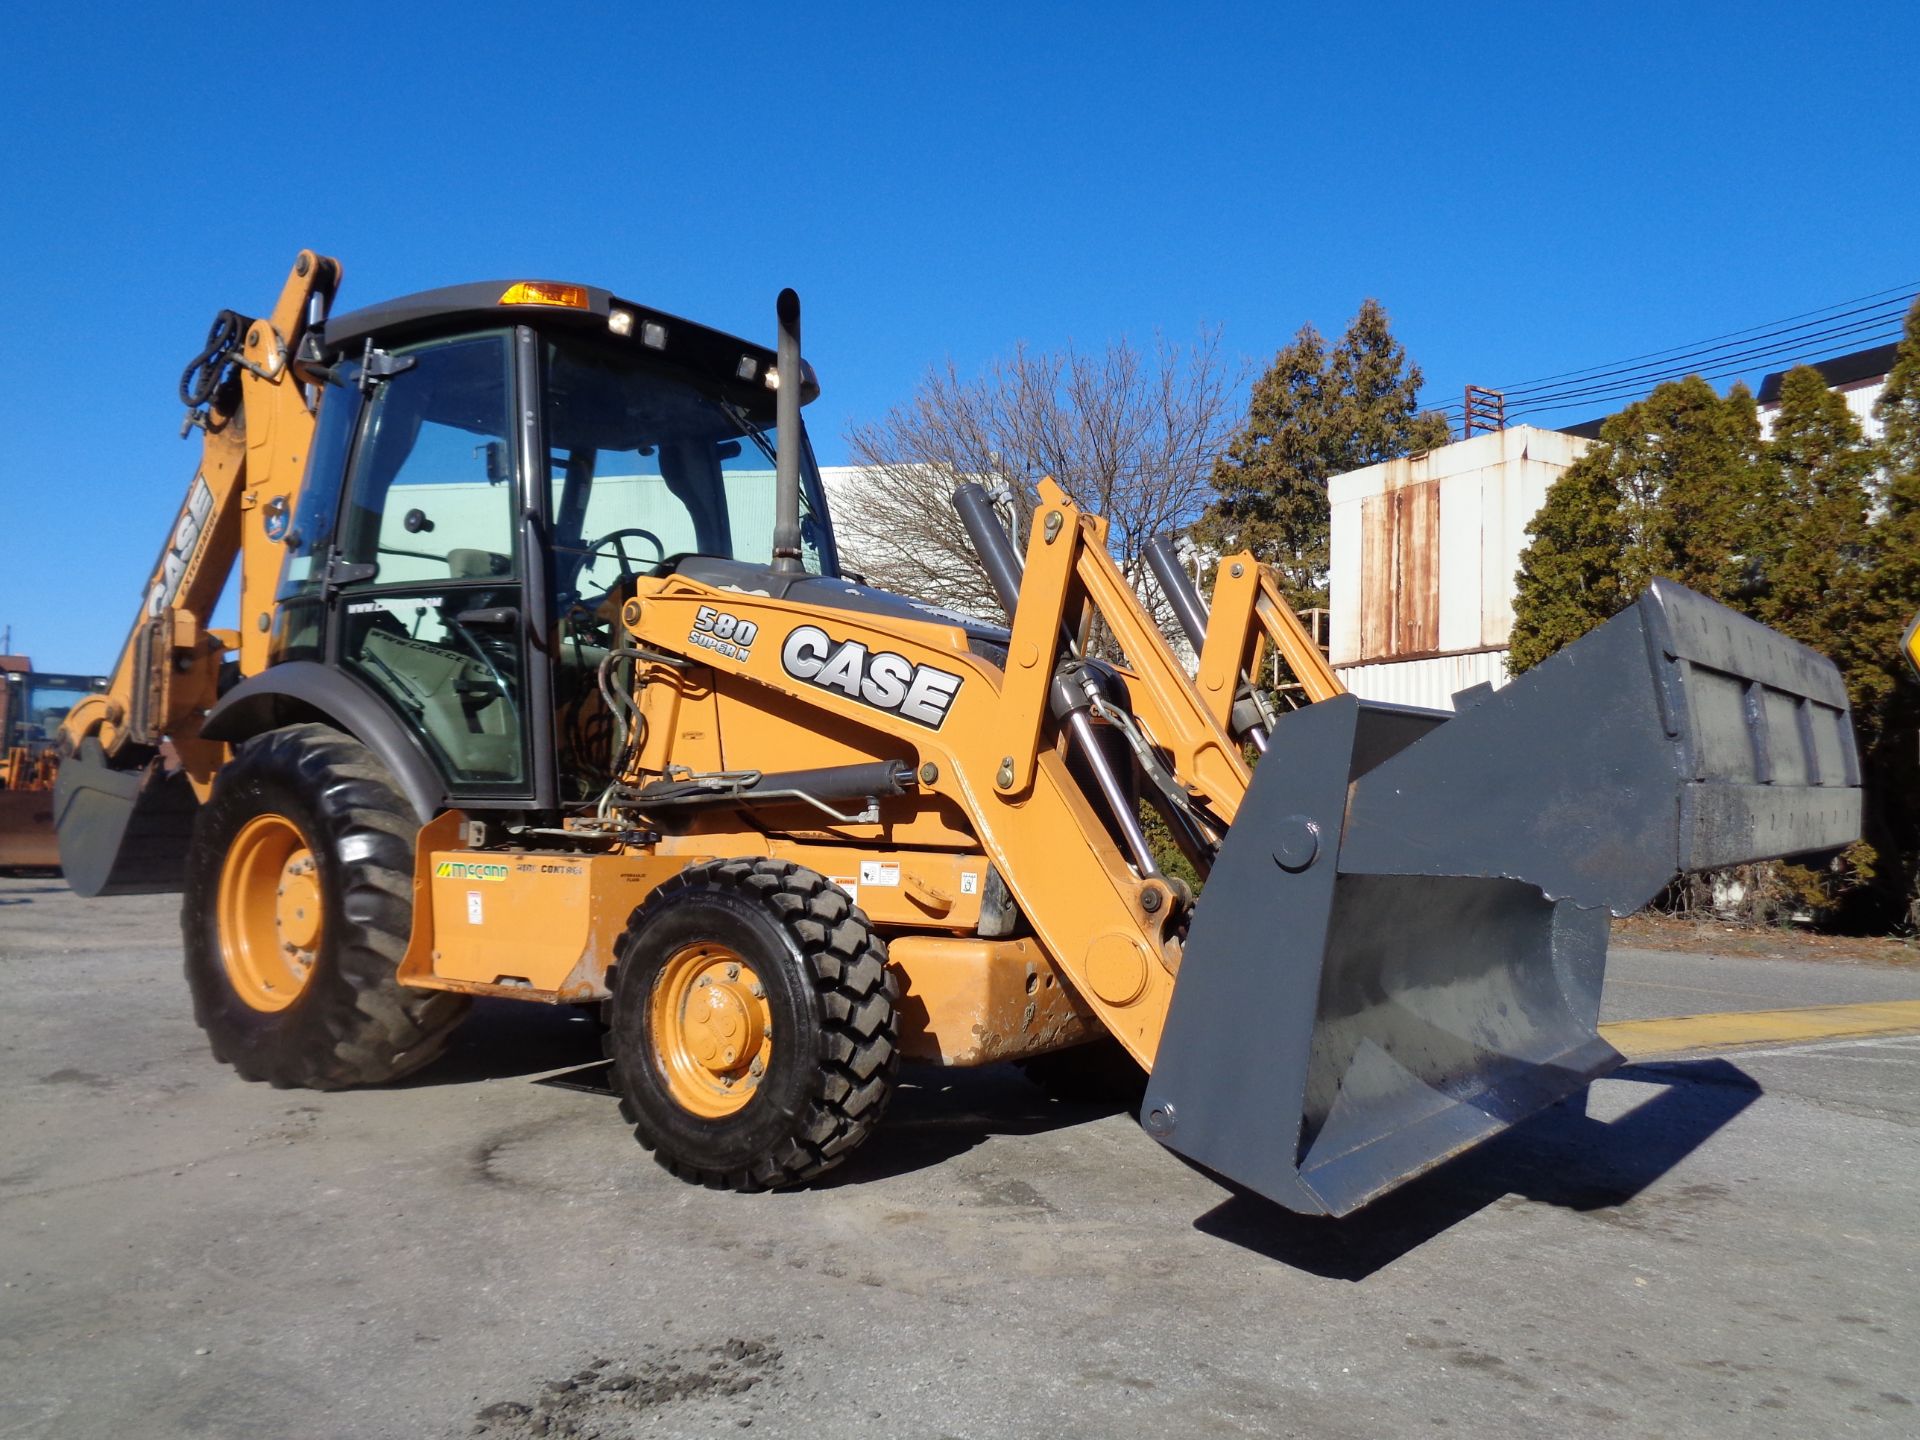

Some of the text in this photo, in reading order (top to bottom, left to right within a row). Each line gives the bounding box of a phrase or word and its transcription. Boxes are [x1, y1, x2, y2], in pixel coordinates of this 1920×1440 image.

[148, 474, 214, 619] CASE
[688, 630, 750, 662] SUPER N
[694, 605, 758, 647] 580
[781, 625, 964, 731] CASE
